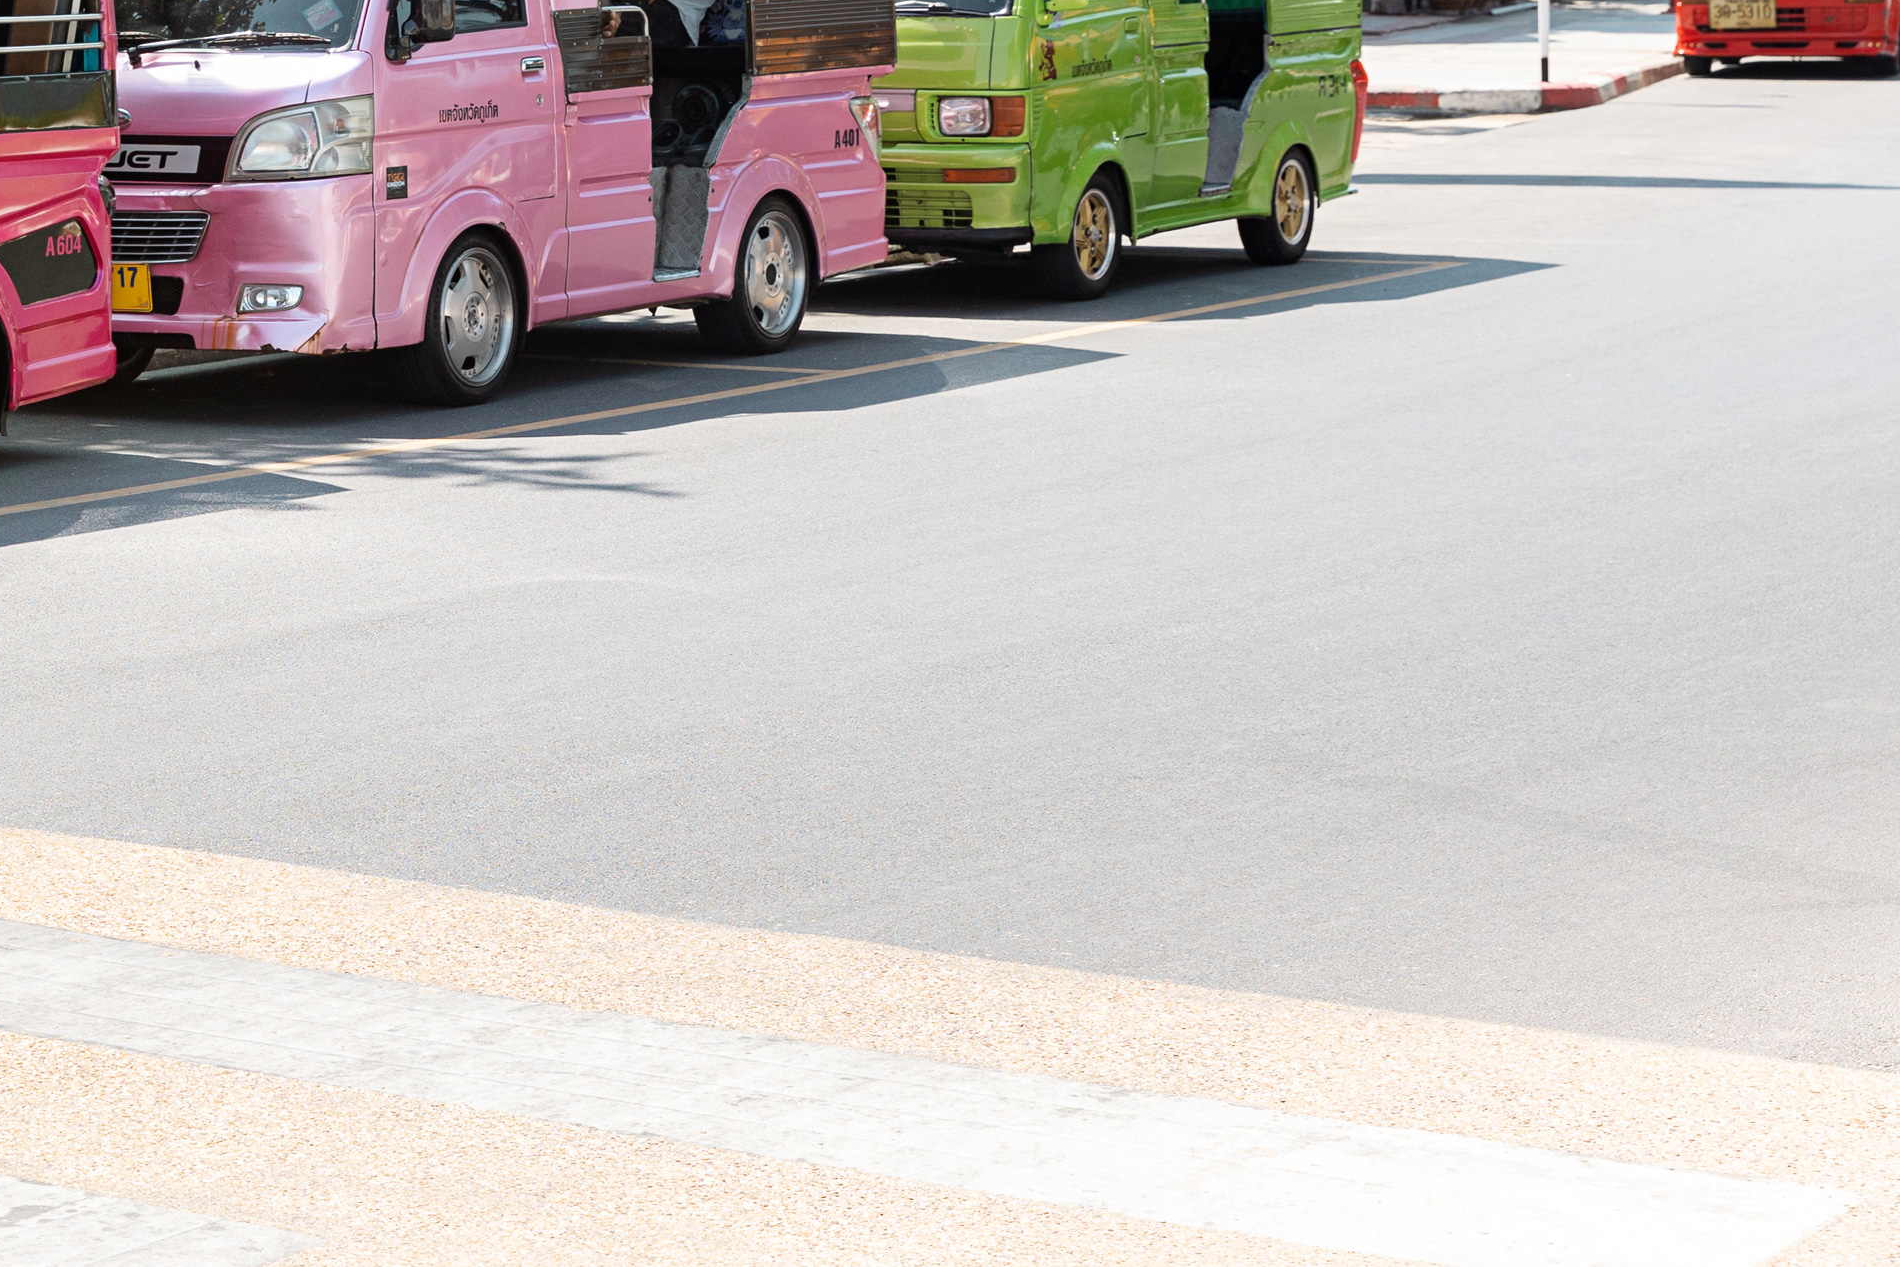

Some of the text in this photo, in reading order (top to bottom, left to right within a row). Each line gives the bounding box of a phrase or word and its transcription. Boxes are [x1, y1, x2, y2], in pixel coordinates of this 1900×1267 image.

[439, 100, 499, 123] เขตจังหวัดภูเก็ต
[45, 234, 82, 257] A604
